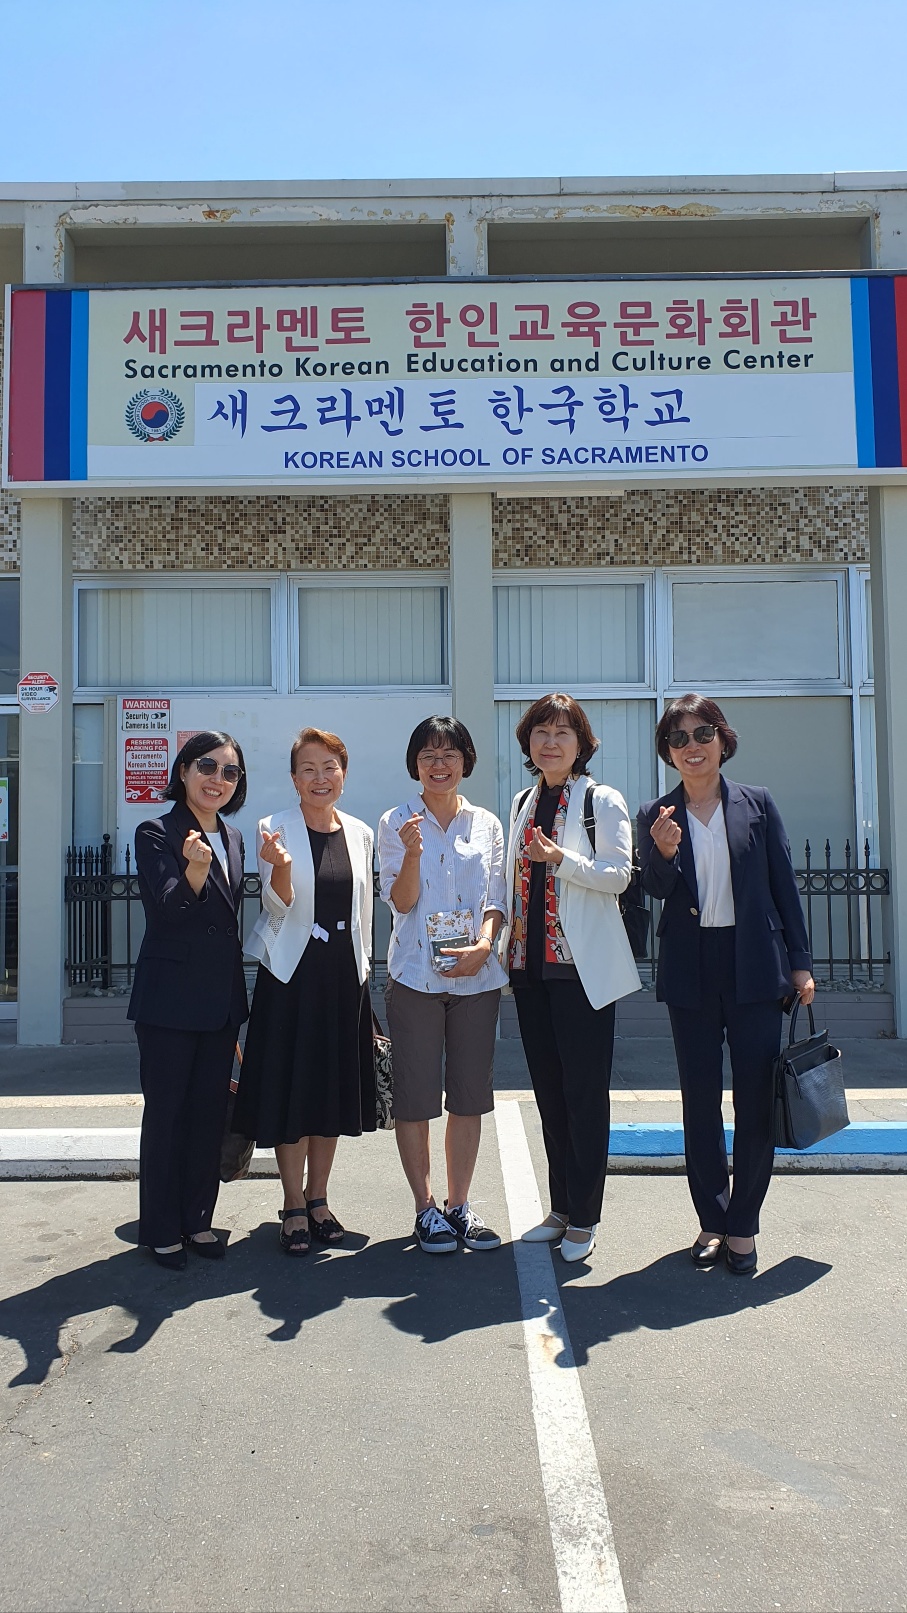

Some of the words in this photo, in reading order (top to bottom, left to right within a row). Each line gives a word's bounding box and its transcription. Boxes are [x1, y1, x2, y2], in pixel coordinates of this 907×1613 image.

[123, 306, 371, 355] 새크라멘토
[405, 297, 817, 348] 한인교육문화회관
[124, 358, 283, 379] Sacramento
[295, 356, 390, 378] Korean
[407, 352, 538, 375] Education
[549, 352, 600, 372] and
[611, 350, 712, 372] Culture
[723, 349, 814, 369] Center
[207, 386, 465, 438] 새크라멘토
[488, 384, 691, 436] 한국학교
[284, 450, 383, 469] KOREAN
[391, 448, 491, 468] SCHOOL
[502, 447, 534, 466] OF
[541, 444, 709, 465] SACRAMENTO
[126, 712, 149, 721] Security
[126, 721, 149, 729] Cameras
